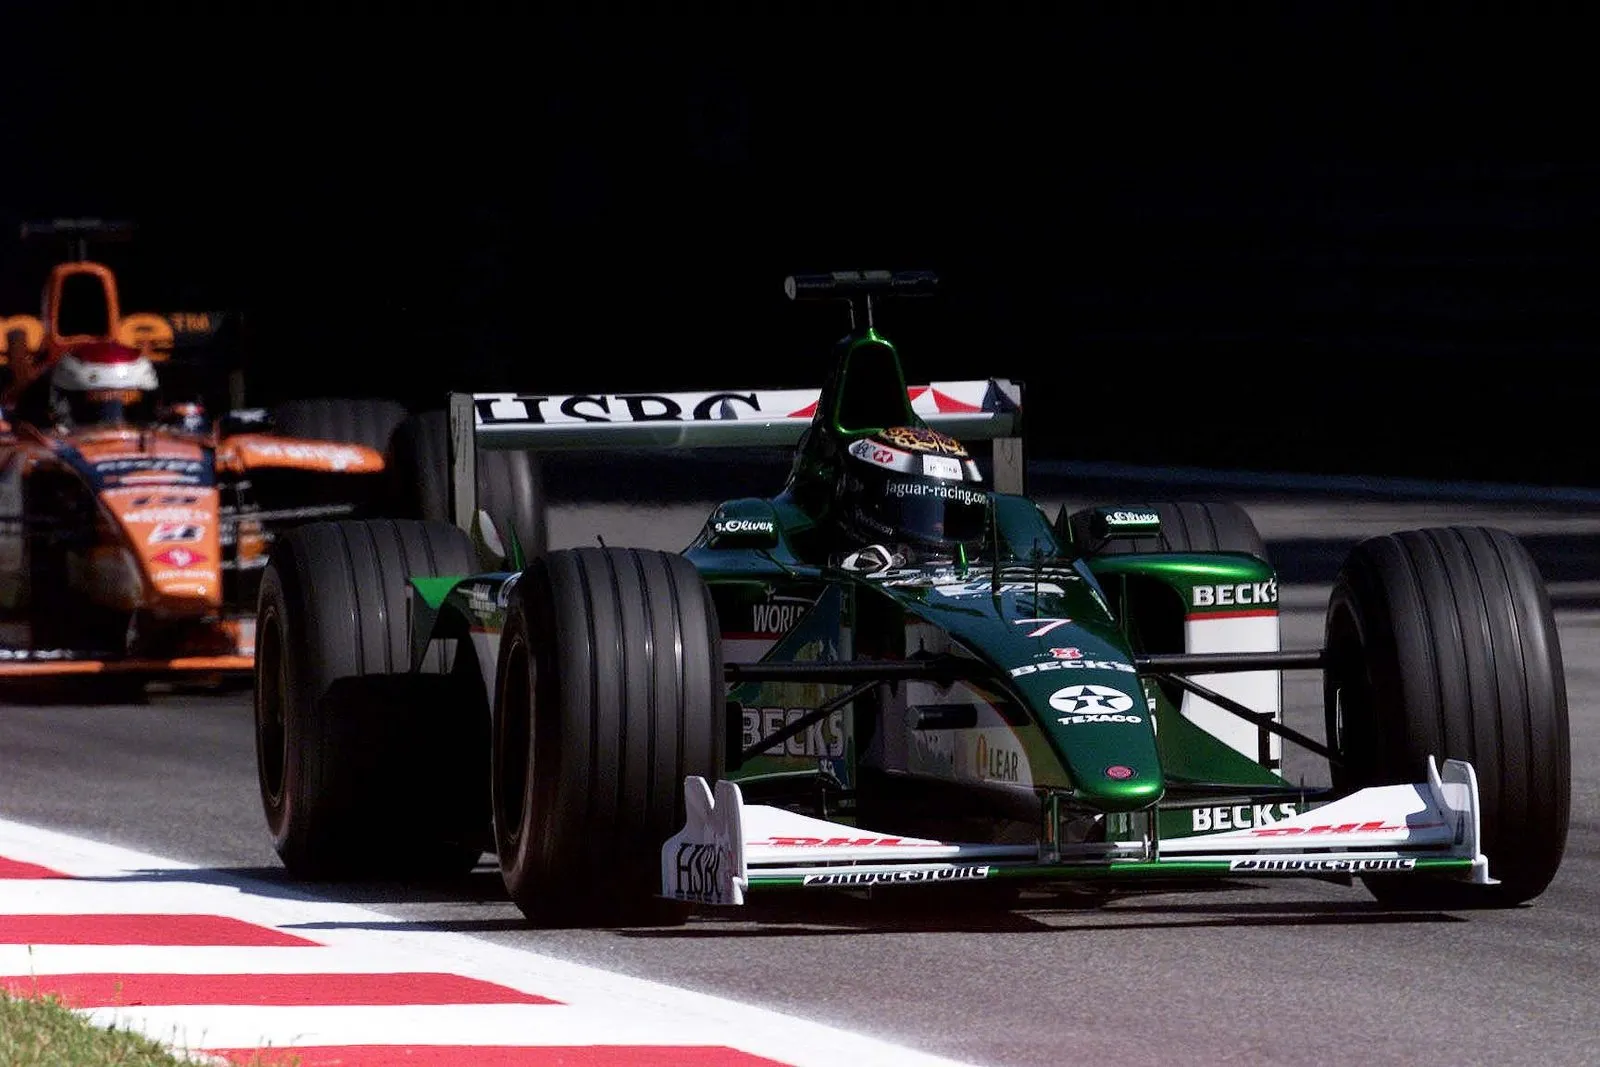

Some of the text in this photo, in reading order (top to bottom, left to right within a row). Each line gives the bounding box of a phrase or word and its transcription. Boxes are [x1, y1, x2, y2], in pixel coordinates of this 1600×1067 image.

[1013, 617, 1073, 638] 7
[1058, 714, 1142, 725] TEXACO
[989, 746, 1019, 782] LEAR
[1251, 820, 1388, 838] DHL
[768, 837, 904, 846] DHL
